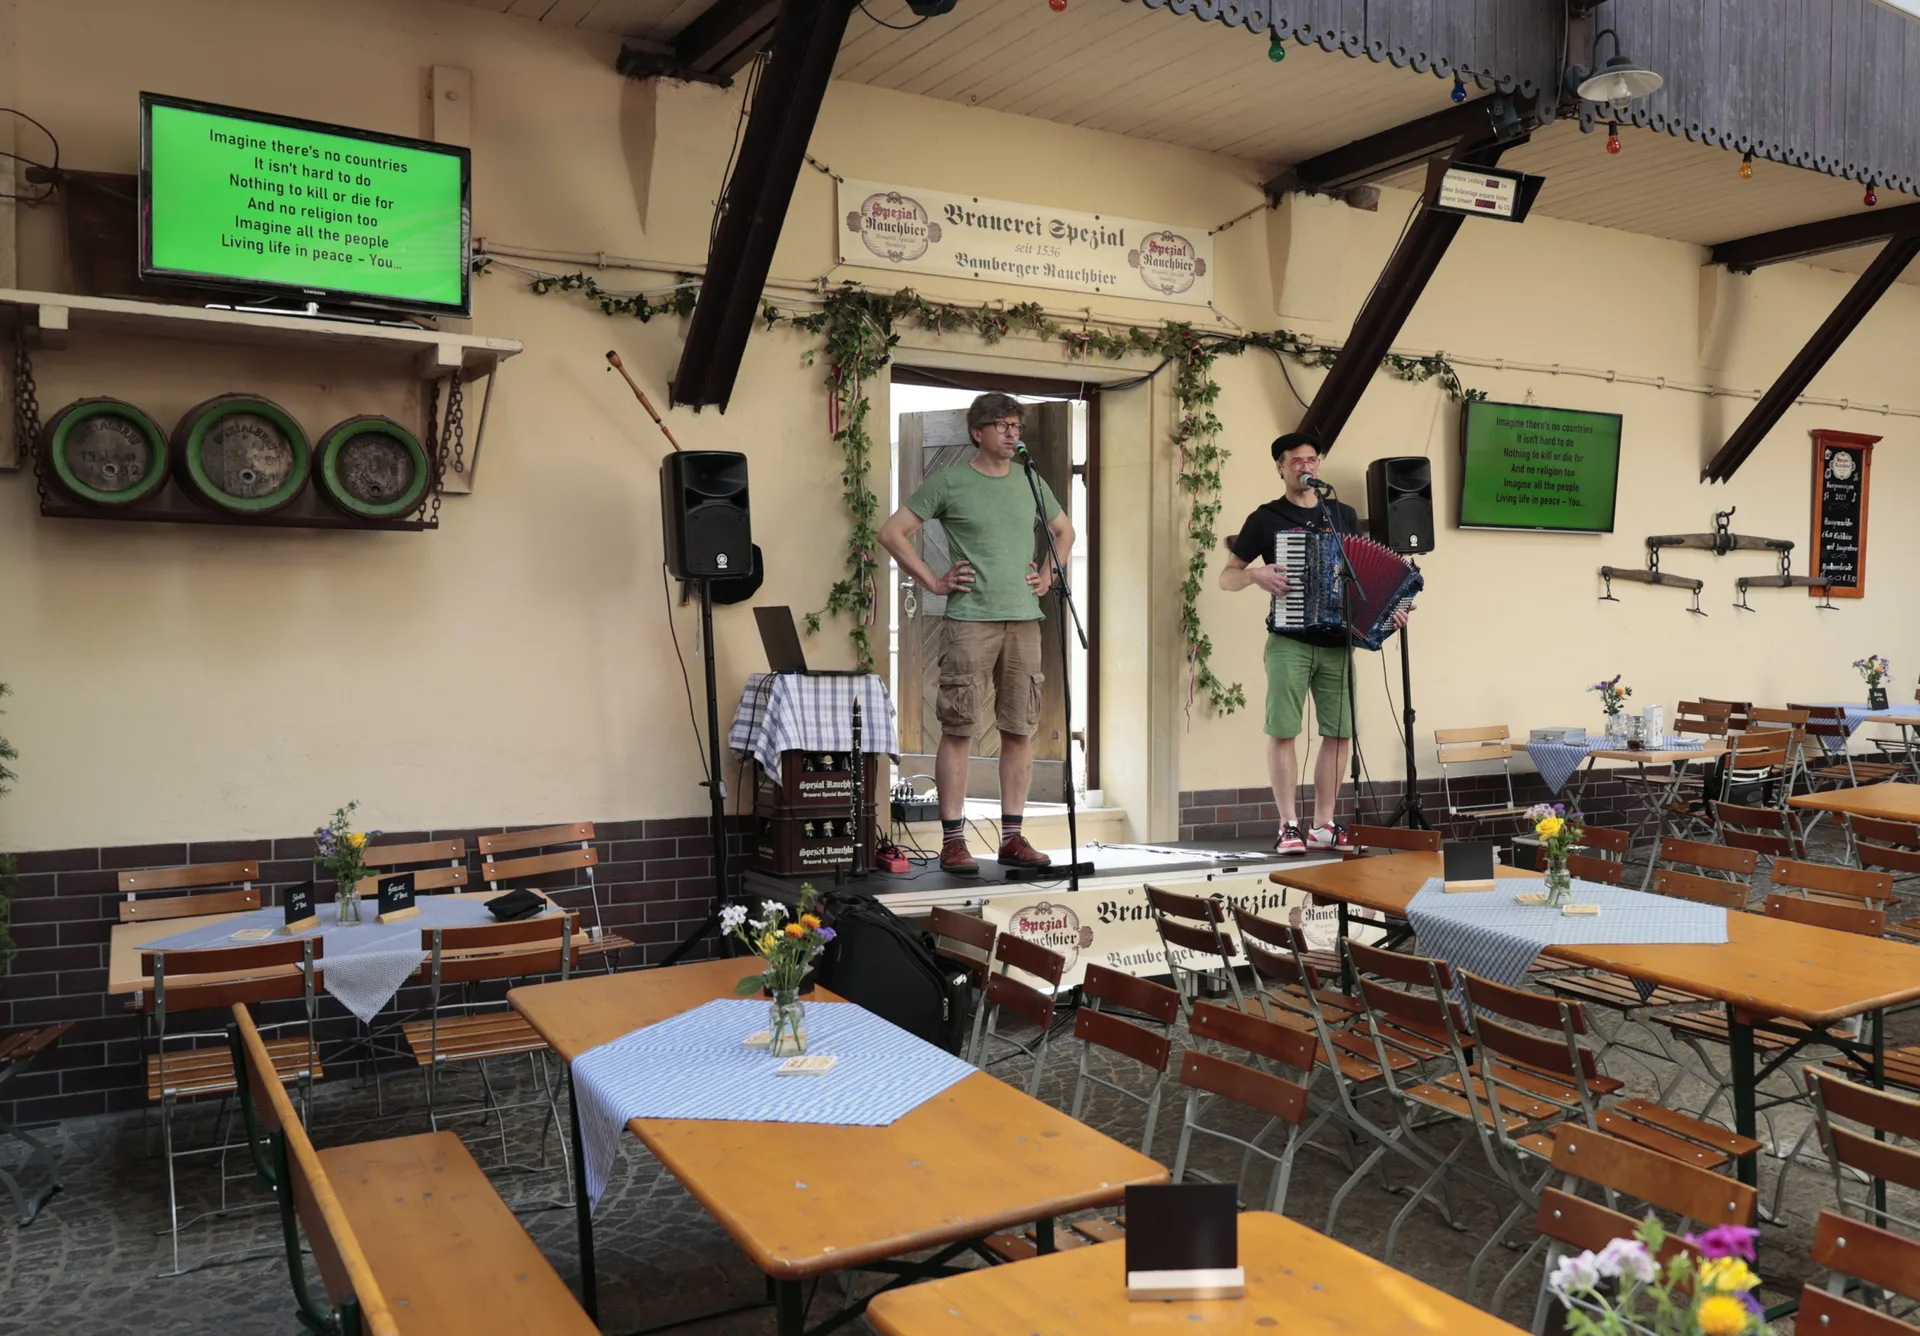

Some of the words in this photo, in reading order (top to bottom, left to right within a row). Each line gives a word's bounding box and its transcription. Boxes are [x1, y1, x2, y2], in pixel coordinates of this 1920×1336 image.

[210, 129, 266, 150] Imagine
[272, 140, 320, 158] there's
[324, 151, 340, 162] no
[345, 154, 408, 173] countries
[254, 156, 263, 170] It
[269, 159, 297, 175] isn't
[302, 164, 333, 180] hard
[338, 171, 351, 183] to
[356, 174, 371, 186] do
[230, 173, 284, 196] Nothing
[289, 183, 302, 196] to
[307, 185, 328, 200] kill
[332, 192, 347, 202] or
[352, 193, 371, 206] die
[376, 196, 394, 209] for
[248, 197, 274, 212] And
[280, 204, 296, 215] no
[301, 206, 352, 223] religion
[357, 214, 378, 227] too
[872, 202, 917, 221] Spezial
[236, 215, 291, 235] Imagine
[296, 225, 313, 238] all
[318, 228, 340, 241] the
[345, 233, 389, 249] people
[866, 216, 926, 237] Rauchbier
[944, 203, 1042, 236] Brauerei
[1049, 218, 1125, 250] Spezial
[222, 234, 264, 254] Living
[269, 240, 290, 255] life
[296, 244, 307, 257] in
[313, 249, 353, 263] peace
[1014, 242, 1033, 254] seit
[1036, 244, 1061, 258] 1536
[1149, 240, 1186, 257] Spezial
[954, 251, 1039, 278] Bamberger
[1043, 263, 1117, 285] Rauchbier
[1143, 254, 1193, 271] Rauchbier
[1496, 416, 1525, 429] Imagine
[1526, 419, 1550, 430] there's
[1562, 424, 1593, 434] countries
[1517, 433, 1521, 443] It
[1523, 434, 1538, 444] isn't
[1540, 436, 1555, 446] hard
[1558, 438, 1564, 446] to
[1566, 438, 1574, 447] do
[1504, 448, 1530, 460] Nothing
[1532, 451, 1539, 459] to
[1541, 450, 1551, 460] kill
[1563, 452, 1572, 462] die
[1574, 453, 1584, 462] for
[1511, 464, 1525, 473] And
[1527, 466, 1535, 474] no
[1537, 465, 1562, 477] religion
[1564, 468, 1575, 476] too
[1504, 478, 1531, 490] Imagine
[1533, 480, 1542, 490] all
[1544, 480, 1555, 490] the
[1557, 482, 1579, 493] people
[1496, 493, 1517, 506] Living
[1519, 494, 1530, 503] life
[1532, 494, 1538, 504] in
[1540, 497, 1560, 506] peace
[799, 780, 824, 790] Spezial
[1019, 914, 1068, 934] Spezial
